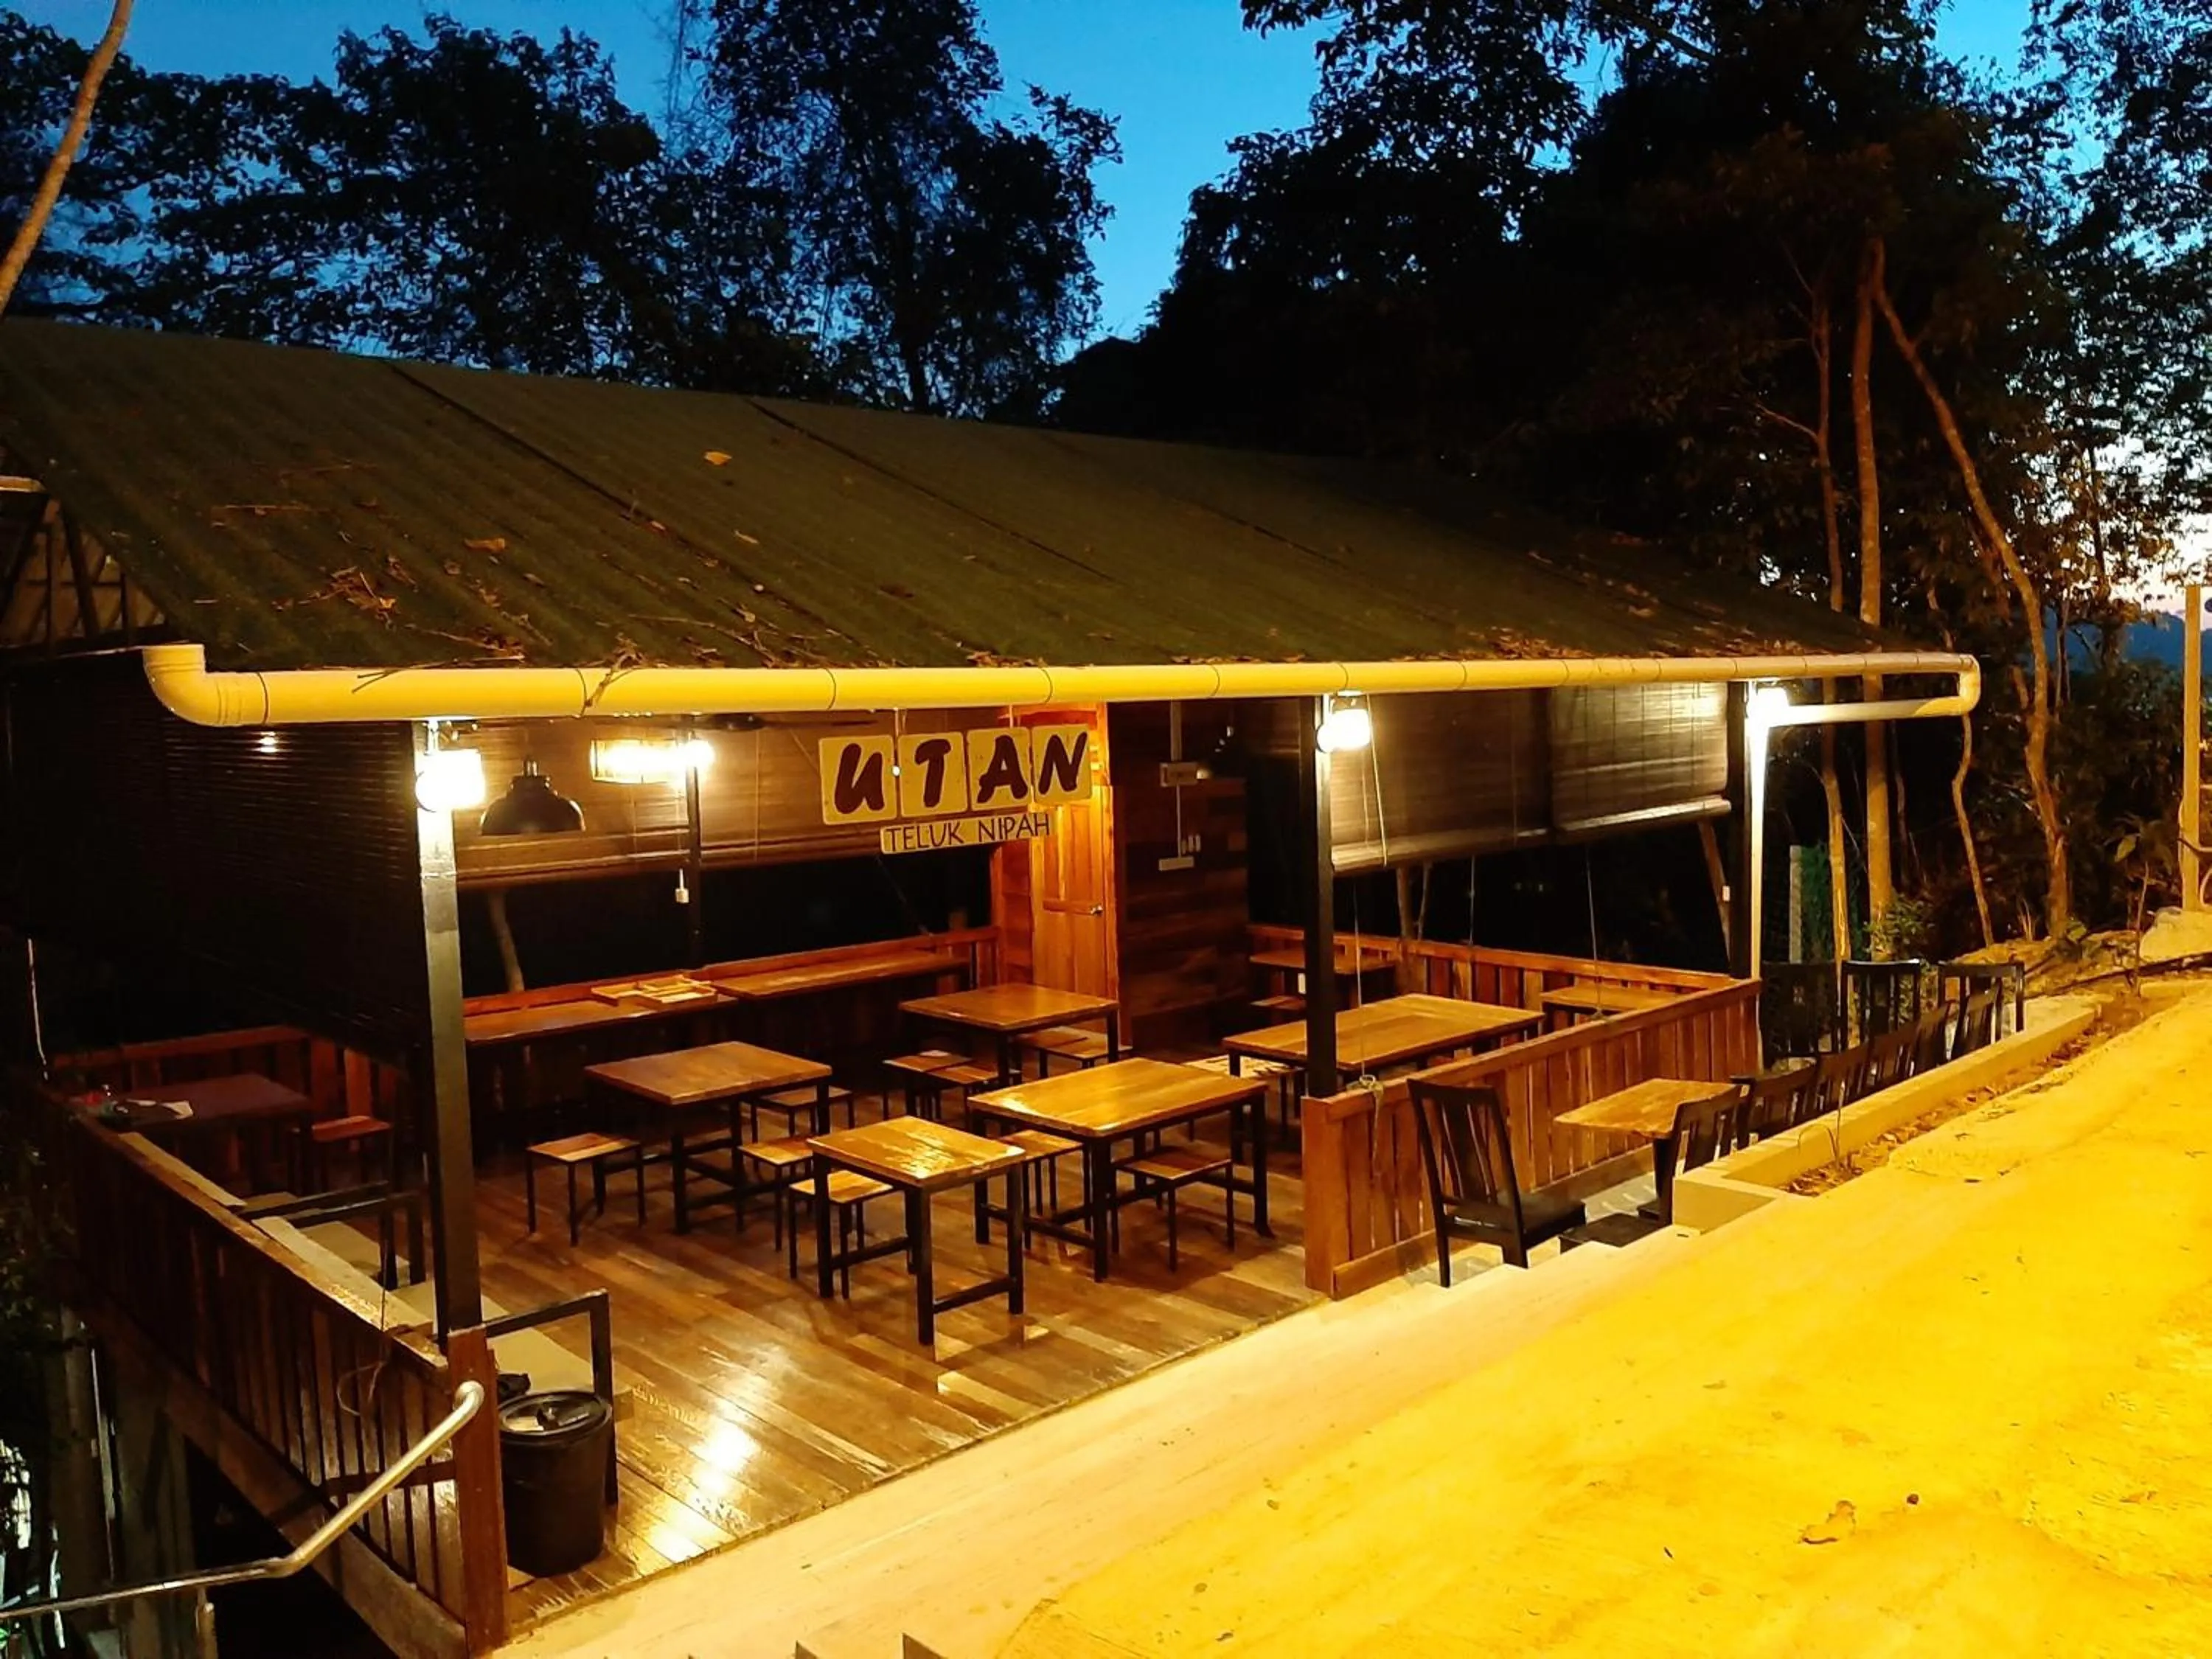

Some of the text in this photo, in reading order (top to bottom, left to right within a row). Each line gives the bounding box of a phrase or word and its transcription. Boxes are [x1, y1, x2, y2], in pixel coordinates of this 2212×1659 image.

[834, 731, 1088, 814] UTAN
[886, 814, 1050, 852] TELUK NIPAH
